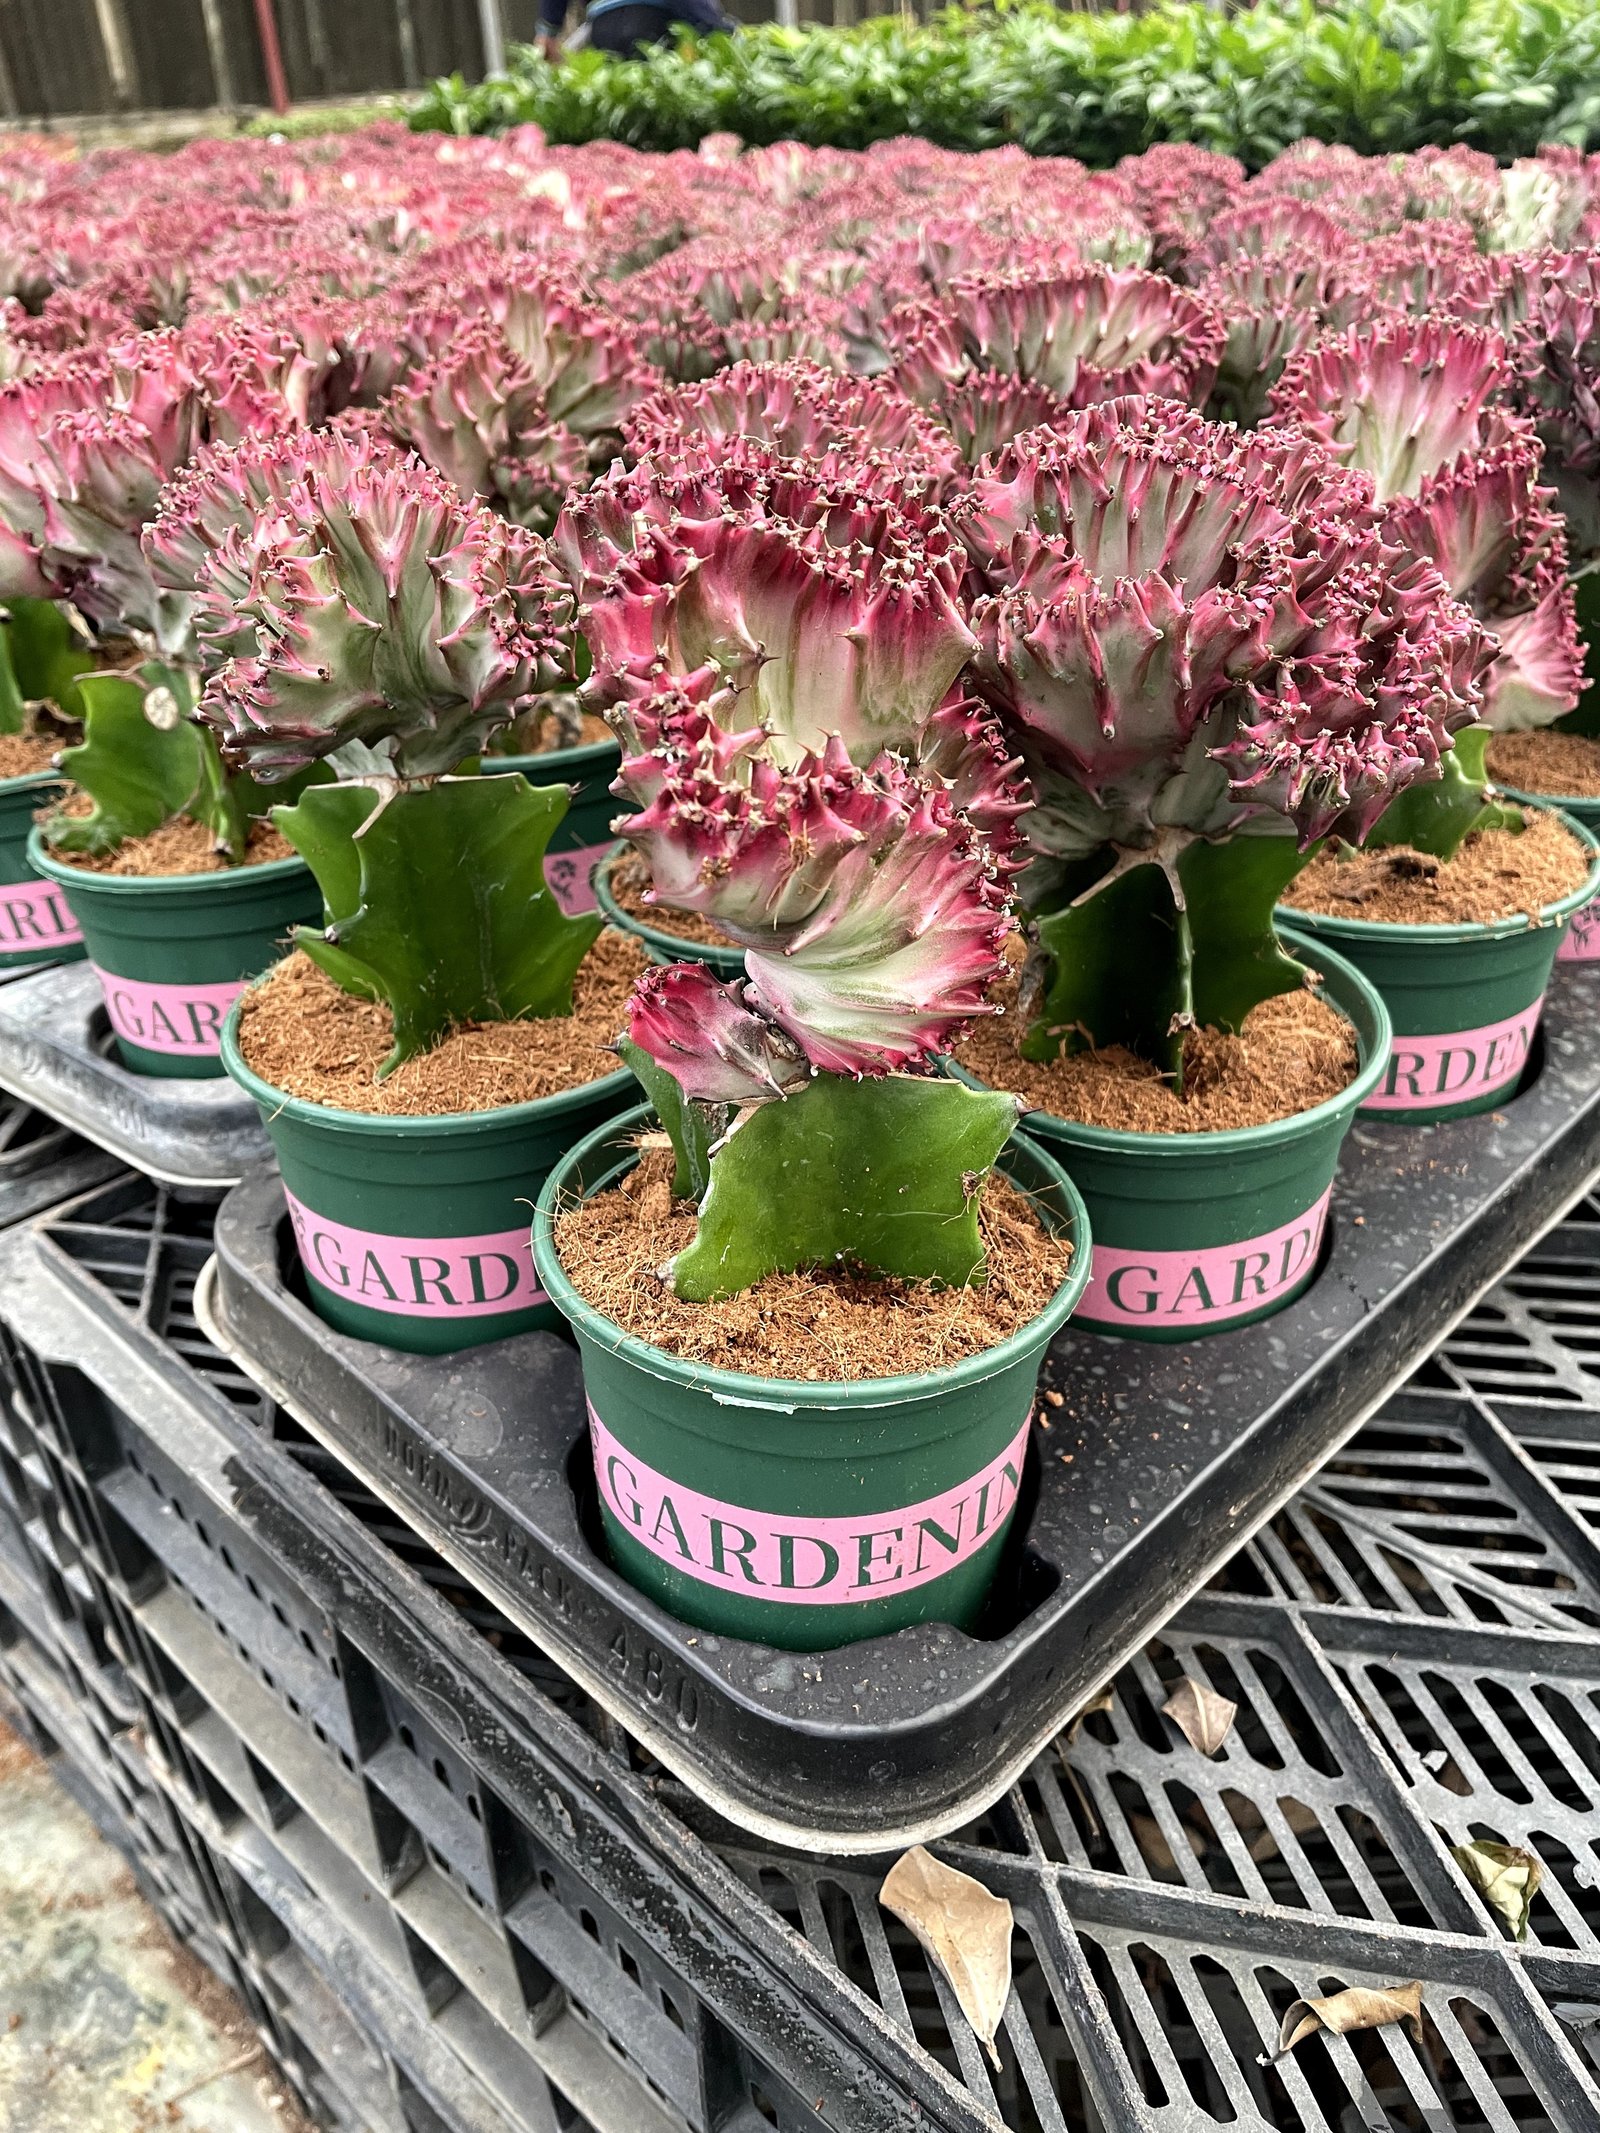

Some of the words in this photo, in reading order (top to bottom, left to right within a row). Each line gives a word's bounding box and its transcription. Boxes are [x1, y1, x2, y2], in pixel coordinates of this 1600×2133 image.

[112, 990, 236, 1045] GAR
[1377, 1025, 1528, 1098] RDEN
[1106, 1205, 1323, 1314] GARD
[610, 1624, 699, 1732] 480
